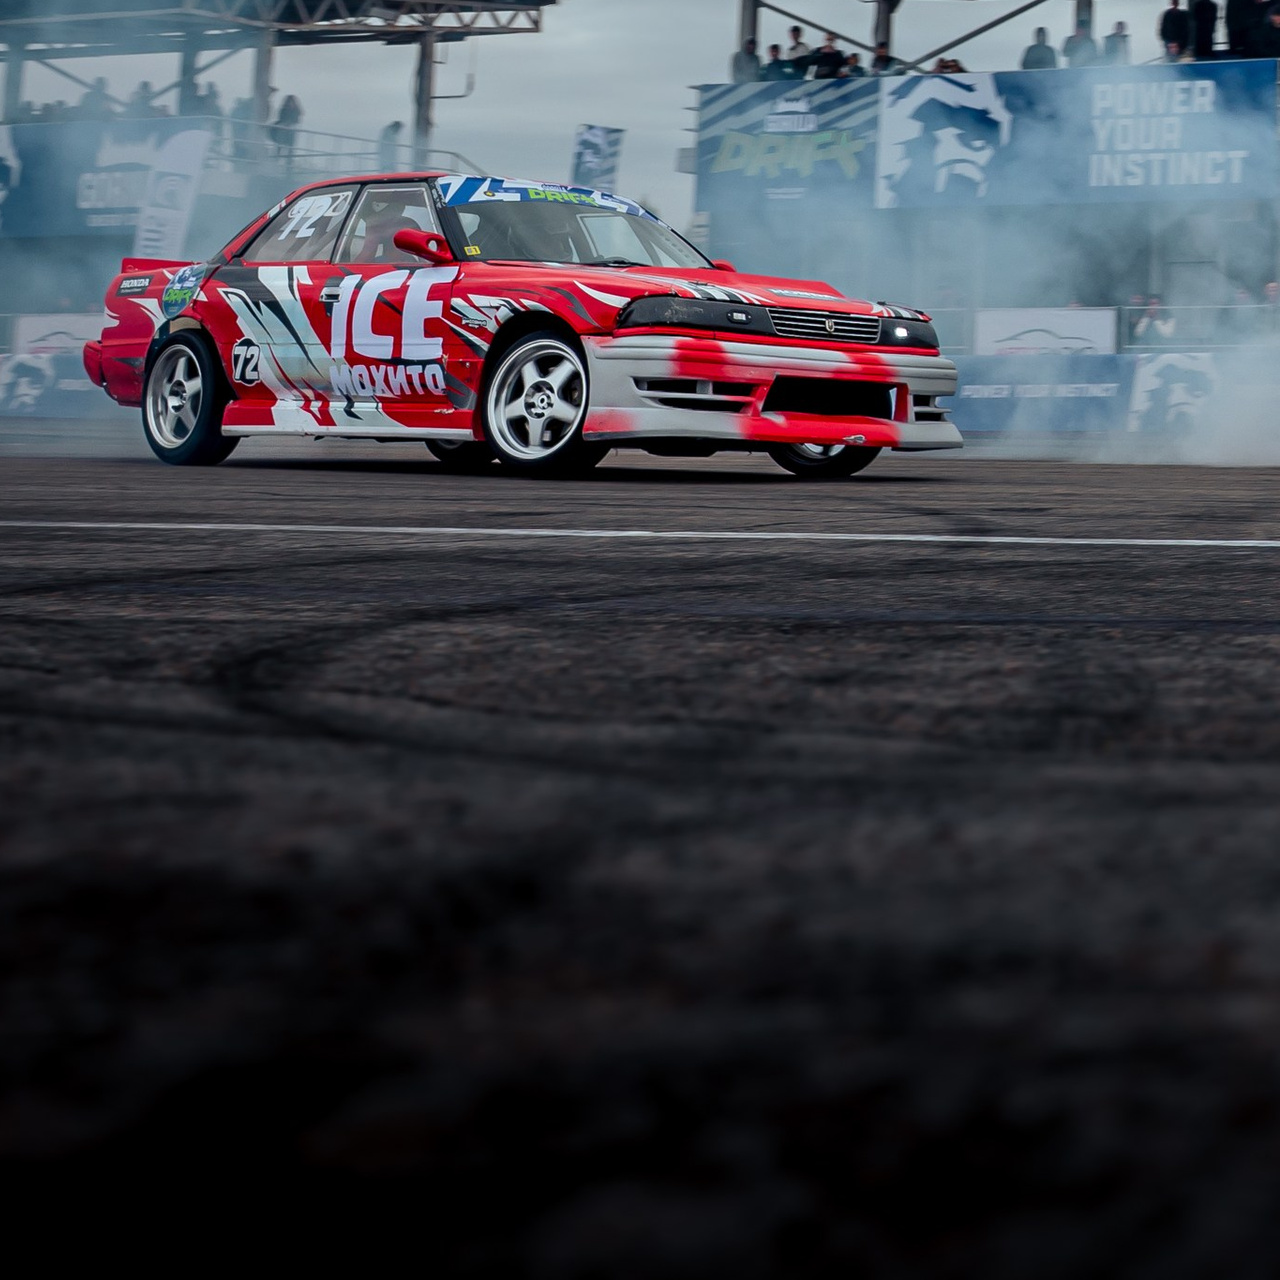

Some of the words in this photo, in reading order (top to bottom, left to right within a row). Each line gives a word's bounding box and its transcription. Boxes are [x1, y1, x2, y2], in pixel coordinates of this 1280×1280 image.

[1091, 80, 1216, 116] POWER
[1092, 117, 1181, 150] YOUR
[1089, 150, 1249, 186] INSTINCT
[527, 188, 600, 207] DRIFT
[120, 278, 150, 289] HONDA
[331, 266, 459, 360] ICE
[233, 345, 260, 380] 72
